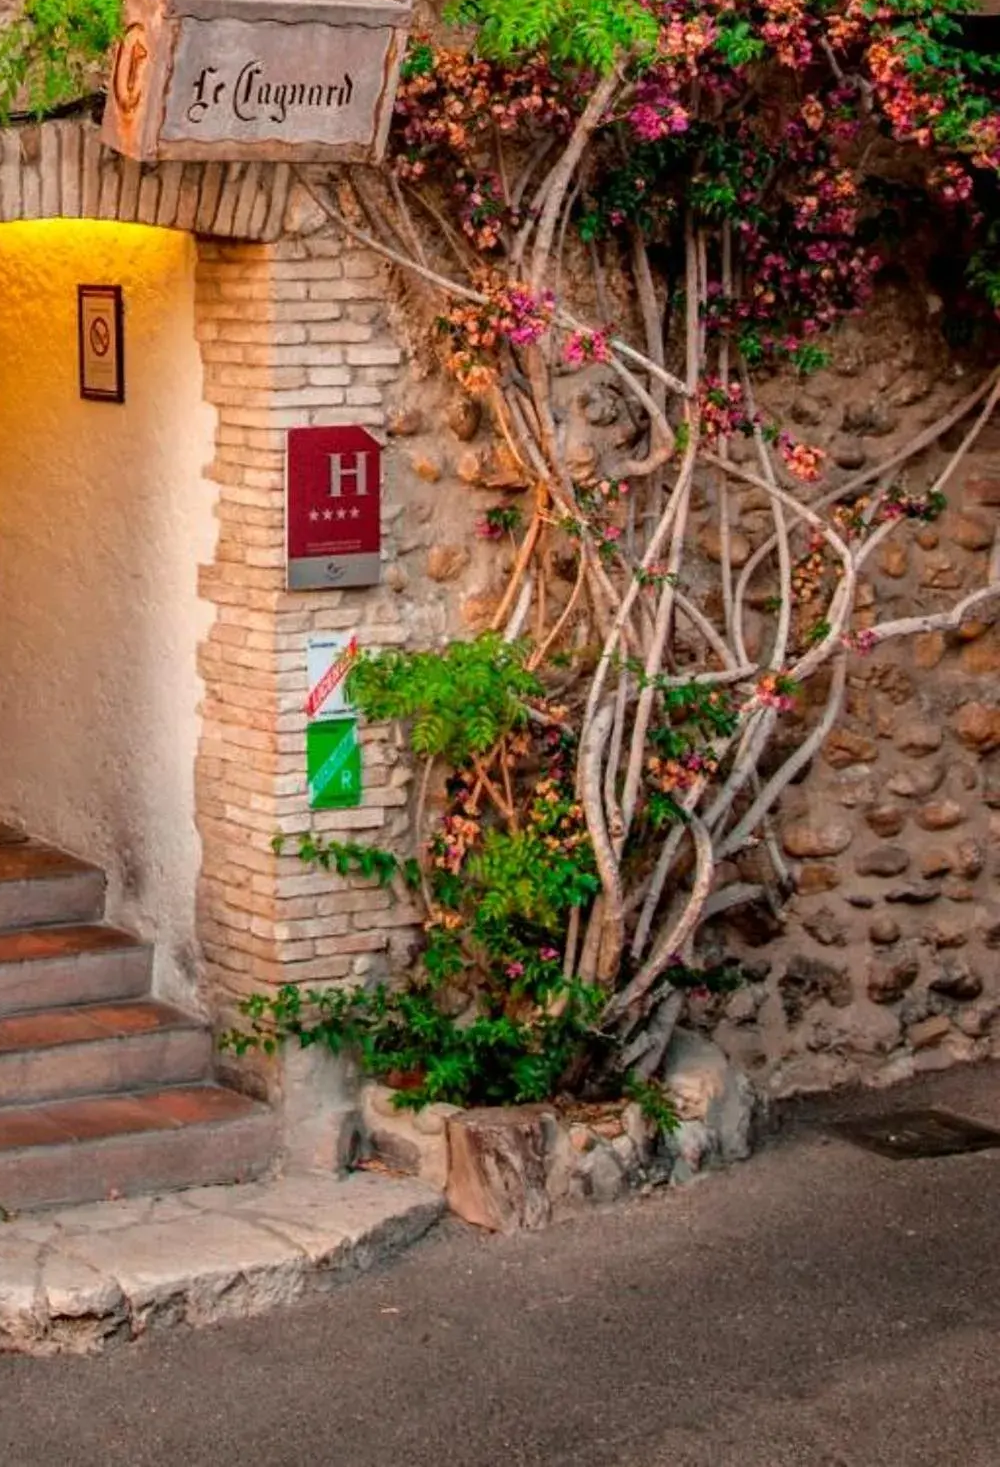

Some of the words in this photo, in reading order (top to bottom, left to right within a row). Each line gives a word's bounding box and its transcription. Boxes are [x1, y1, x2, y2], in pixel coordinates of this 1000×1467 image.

[187, 66, 226, 123] Le
[325, 451, 370, 498] H
[341, 769, 353, 790] R
